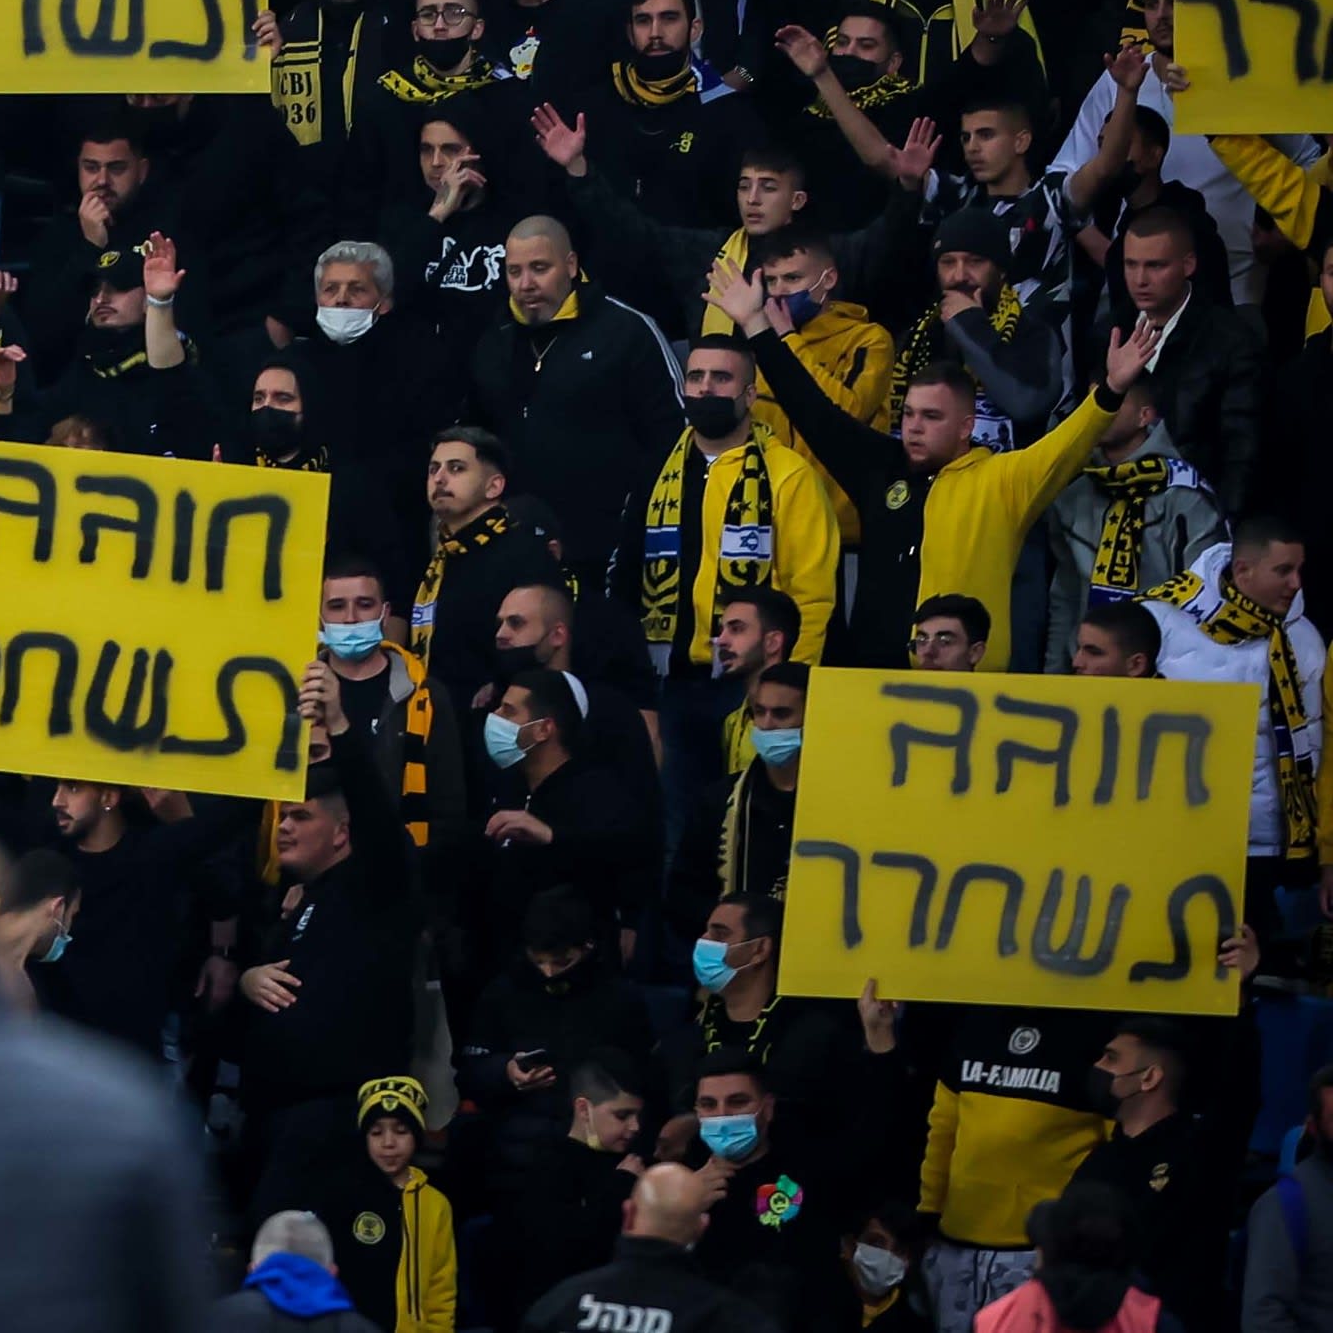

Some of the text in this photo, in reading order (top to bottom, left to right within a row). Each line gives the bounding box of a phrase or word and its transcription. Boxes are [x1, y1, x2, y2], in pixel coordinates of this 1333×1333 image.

[882, 683, 1214, 807] חוגג
[959, 1058, 1062, 1094] LA-FAMILIA
[576, 1291, 675, 1333] מנהל
